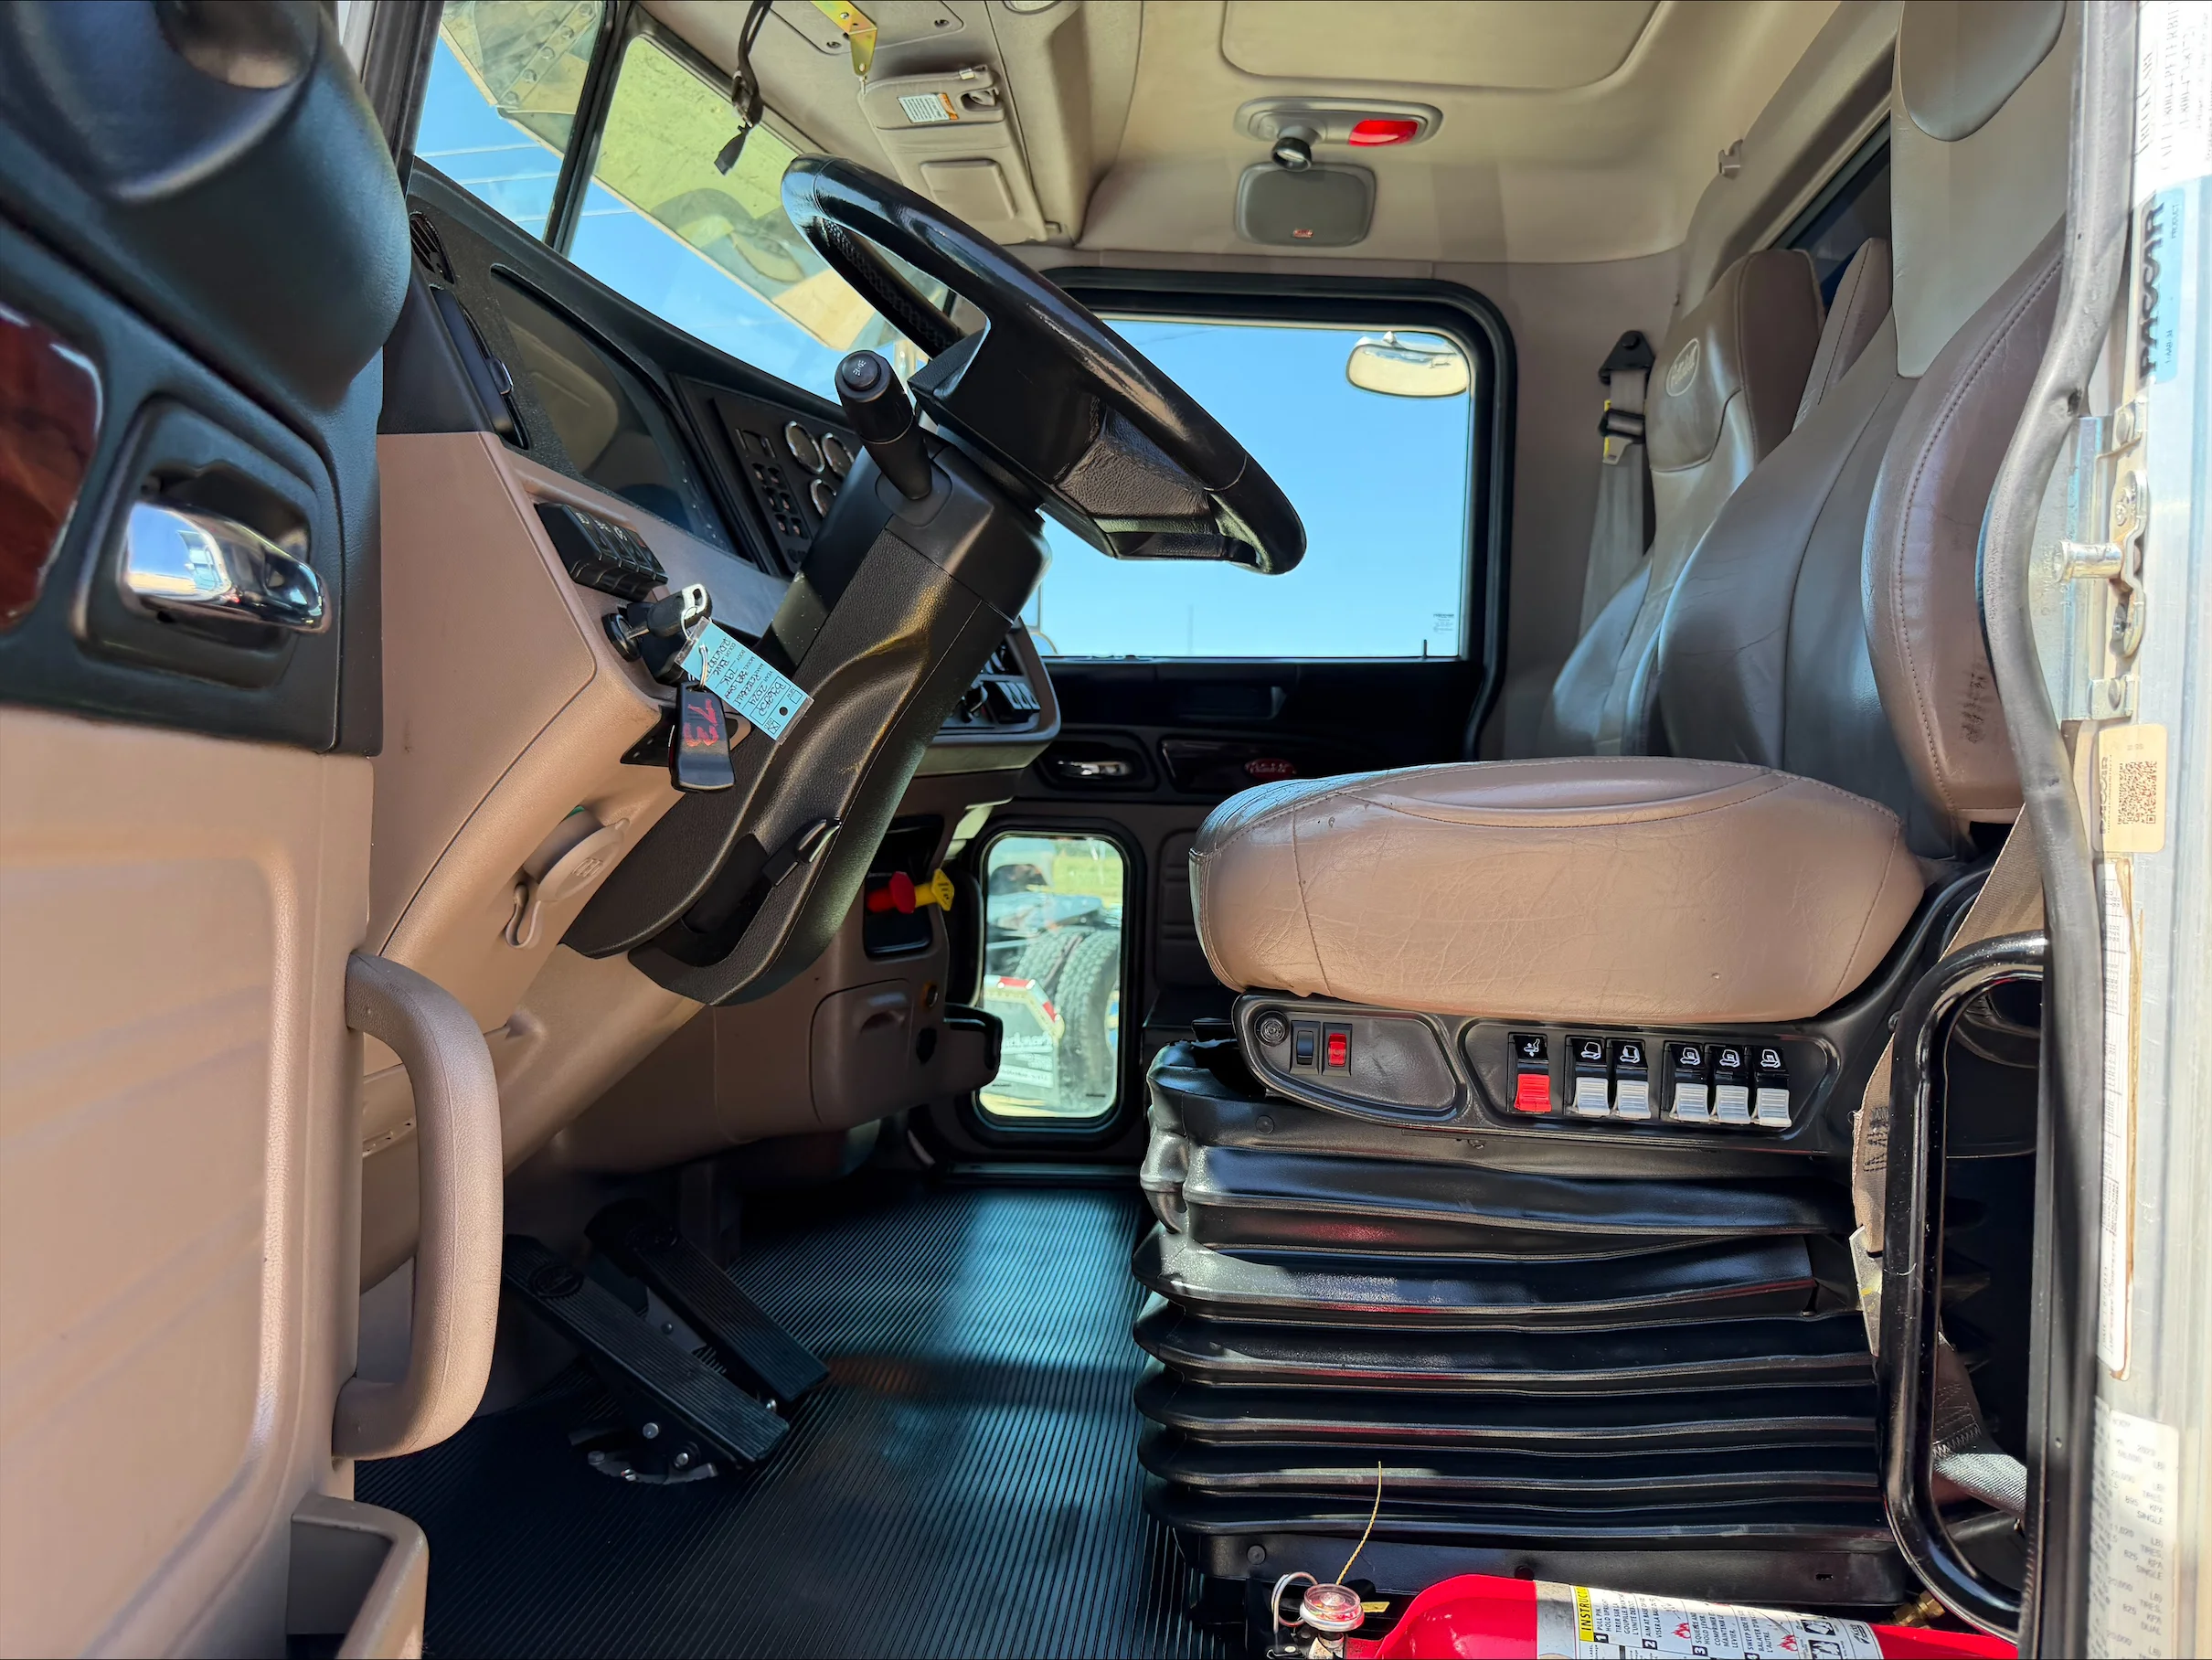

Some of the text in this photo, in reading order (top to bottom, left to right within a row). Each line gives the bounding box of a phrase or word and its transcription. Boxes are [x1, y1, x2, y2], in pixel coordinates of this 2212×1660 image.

[2140, 202, 2165, 379] PACCAR
[749, 685, 768, 706] 2024
[682, 698, 719, 747] 73
[1742, 1632, 1754, 1651] SWEEP
[1754, 1629, 1765, 1652] BALAYER
